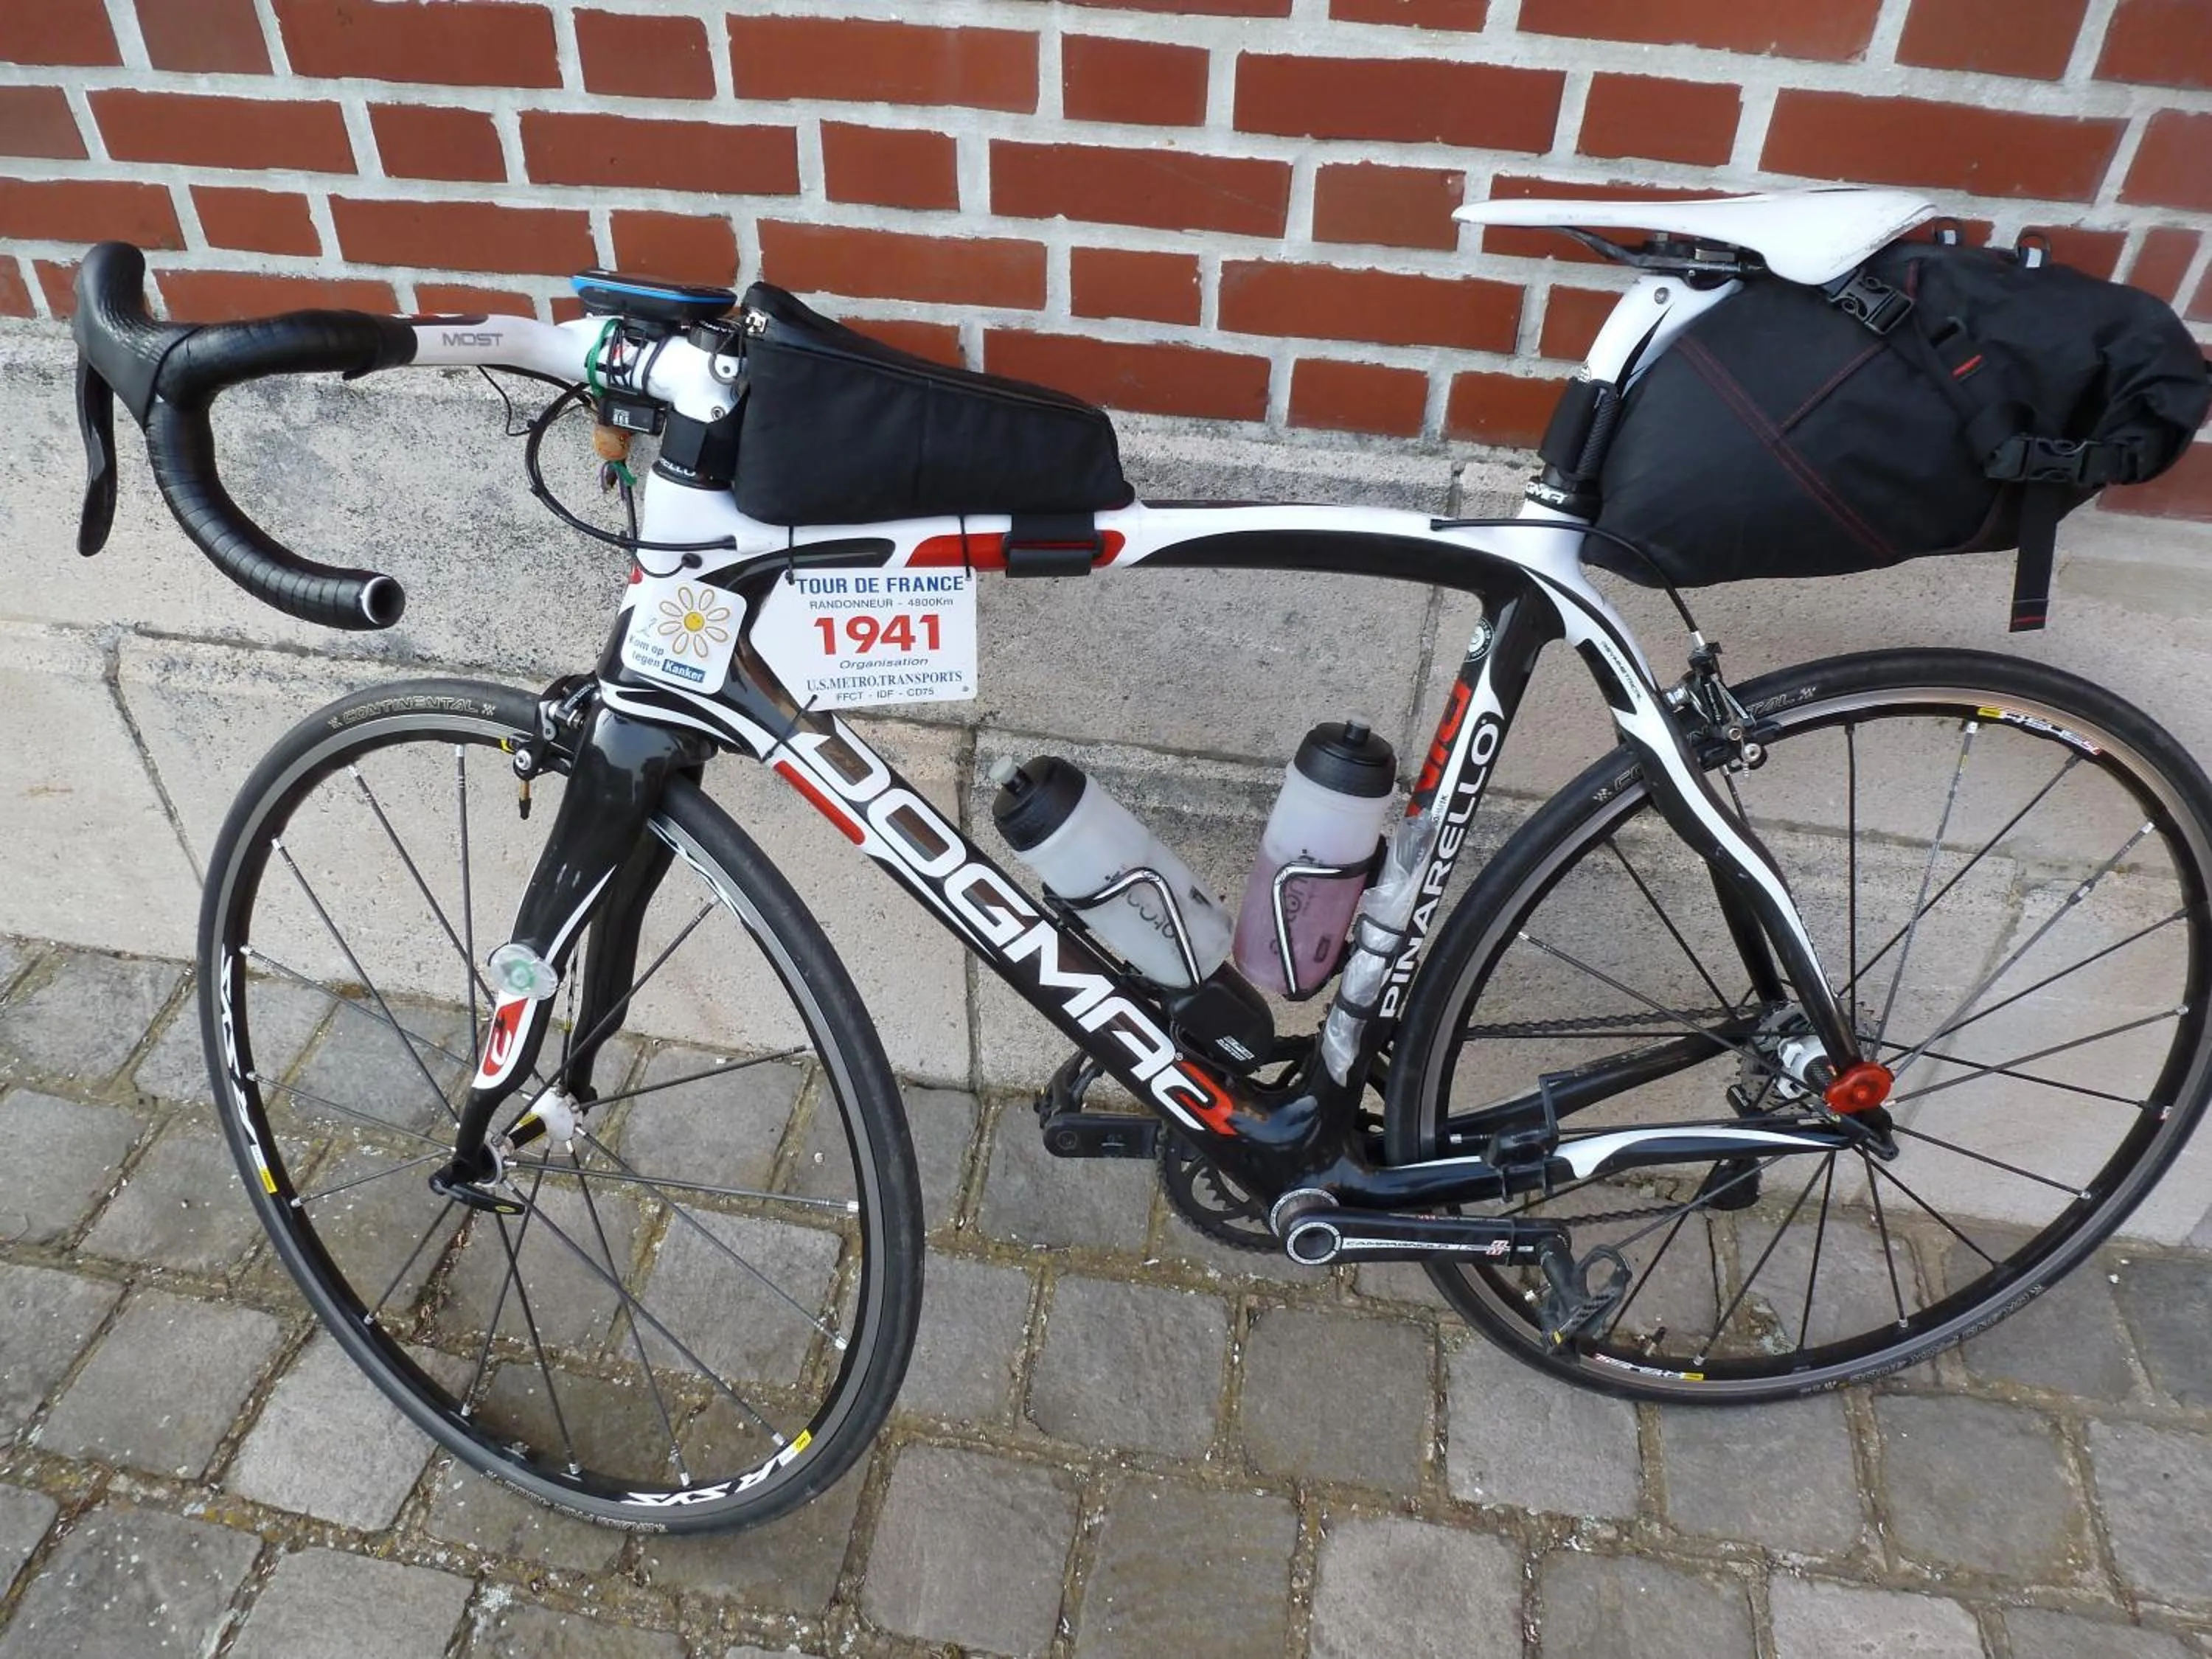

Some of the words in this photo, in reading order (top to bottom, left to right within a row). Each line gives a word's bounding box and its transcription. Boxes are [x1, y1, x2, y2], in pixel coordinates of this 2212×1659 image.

[442, 332, 504, 347] MOST
[796, 578, 847, 594] TOUR
[855, 577, 880, 593] DE
[887, 575, 964, 592] FRANCE
[810, 599, 894, 610] RANDONNEUR
[813, 613, 941, 655] 1941
[651, 644, 664, 655] op
[632, 650, 661, 667] tegen
[664, 660, 703, 681] Kanker
[839, 657, 929, 670] Organisation
[836, 689, 863, 701] FFCT
[877, 689, 894, 698] IDF
[908, 687, 935, 698] CD75
[342, 695, 479, 724] CONTINENTAL
[1379, 723, 1499, 1018] PINARELLO
[783, 714, 1177, 1080] DOGMA
